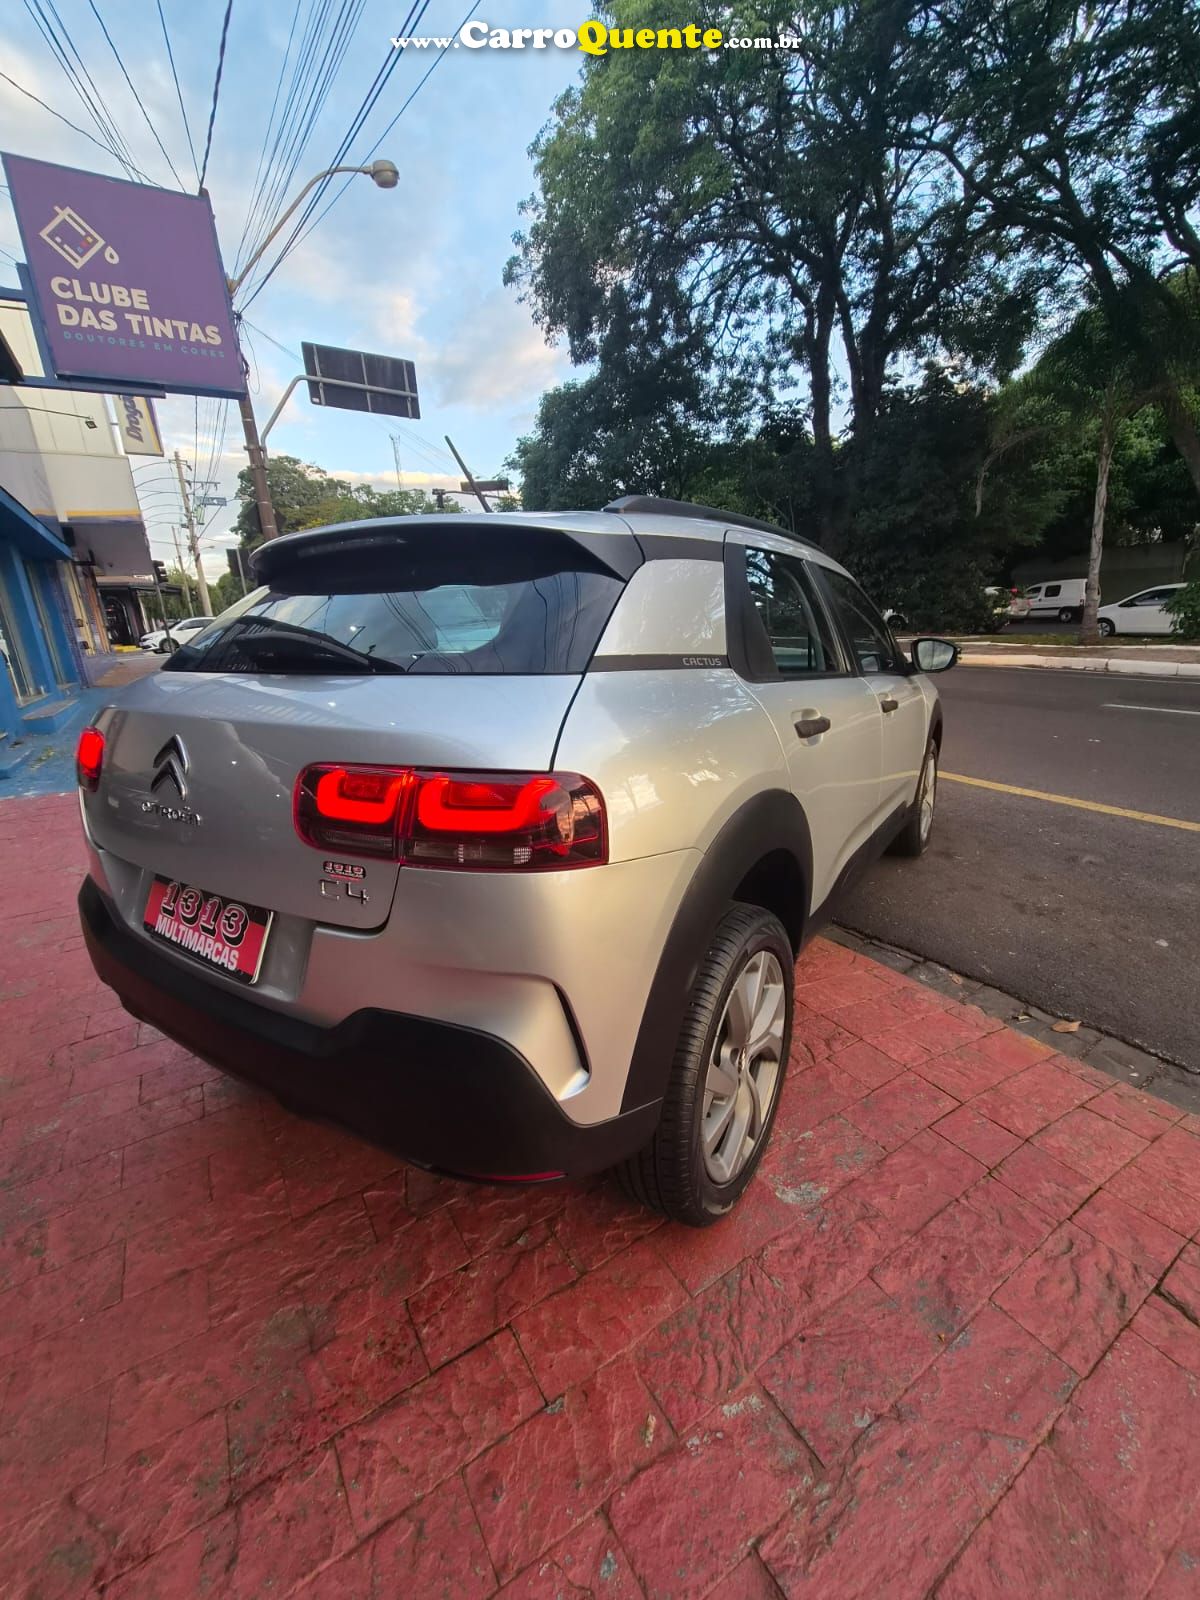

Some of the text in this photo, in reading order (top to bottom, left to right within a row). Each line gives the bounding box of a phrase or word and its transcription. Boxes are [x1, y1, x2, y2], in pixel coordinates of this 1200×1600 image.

[50, 276, 150, 311] CLUBE
[56, 303, 222, 345] DAS TINTAS
[63, 330, 225, 358] DOUTORES EM CORES
[122, 395, 144, 443] Droga
[682, 657, 722, 666] CACTUS
[320, 879, 369, 905] C4
[160, 881, 250, 948] 1313
[155, 913, 240, 971] MULTIMARCAS
